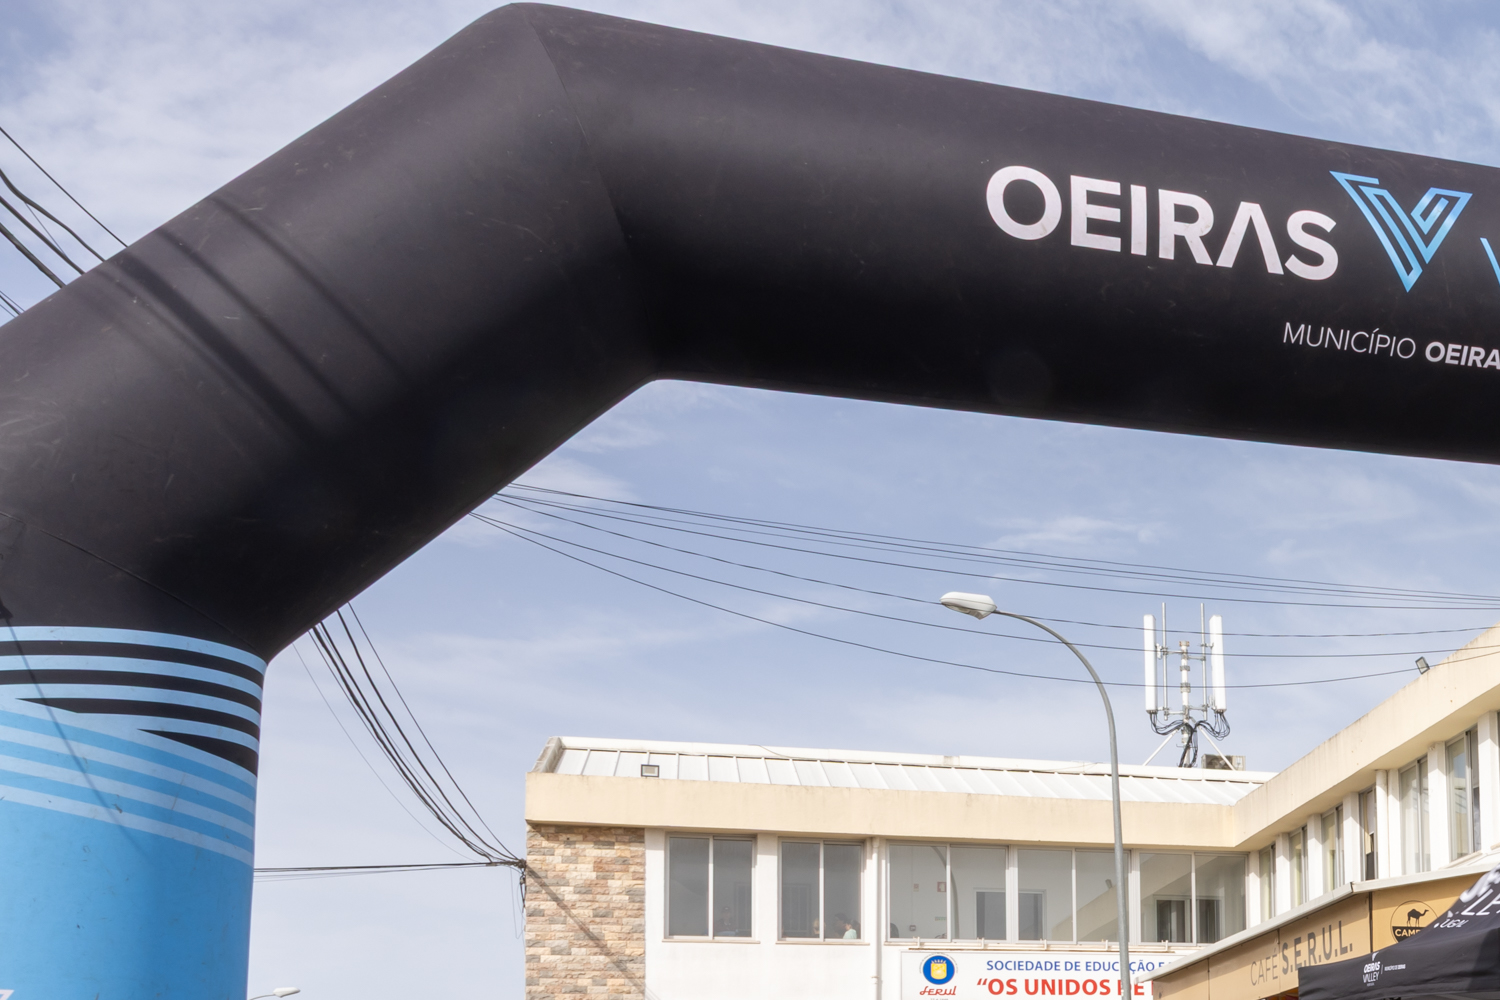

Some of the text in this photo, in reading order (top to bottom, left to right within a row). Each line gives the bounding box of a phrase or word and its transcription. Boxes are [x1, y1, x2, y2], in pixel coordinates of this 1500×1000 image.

[985, 164, 1339, 281] OEIRAS
[1281, 321, 1417, 360] MUNICÍPIO
[986, 960, 1060, 972] SOCIEDADE
[1064, 961, 1081, 972] DE
[1085, 959, 1155, 974] EDUCÇÃO
[1250, 920, 1353, 987] CAFÉ S.E.R.U.L.
[1024, 978, 1111, 996] UNIDOS
